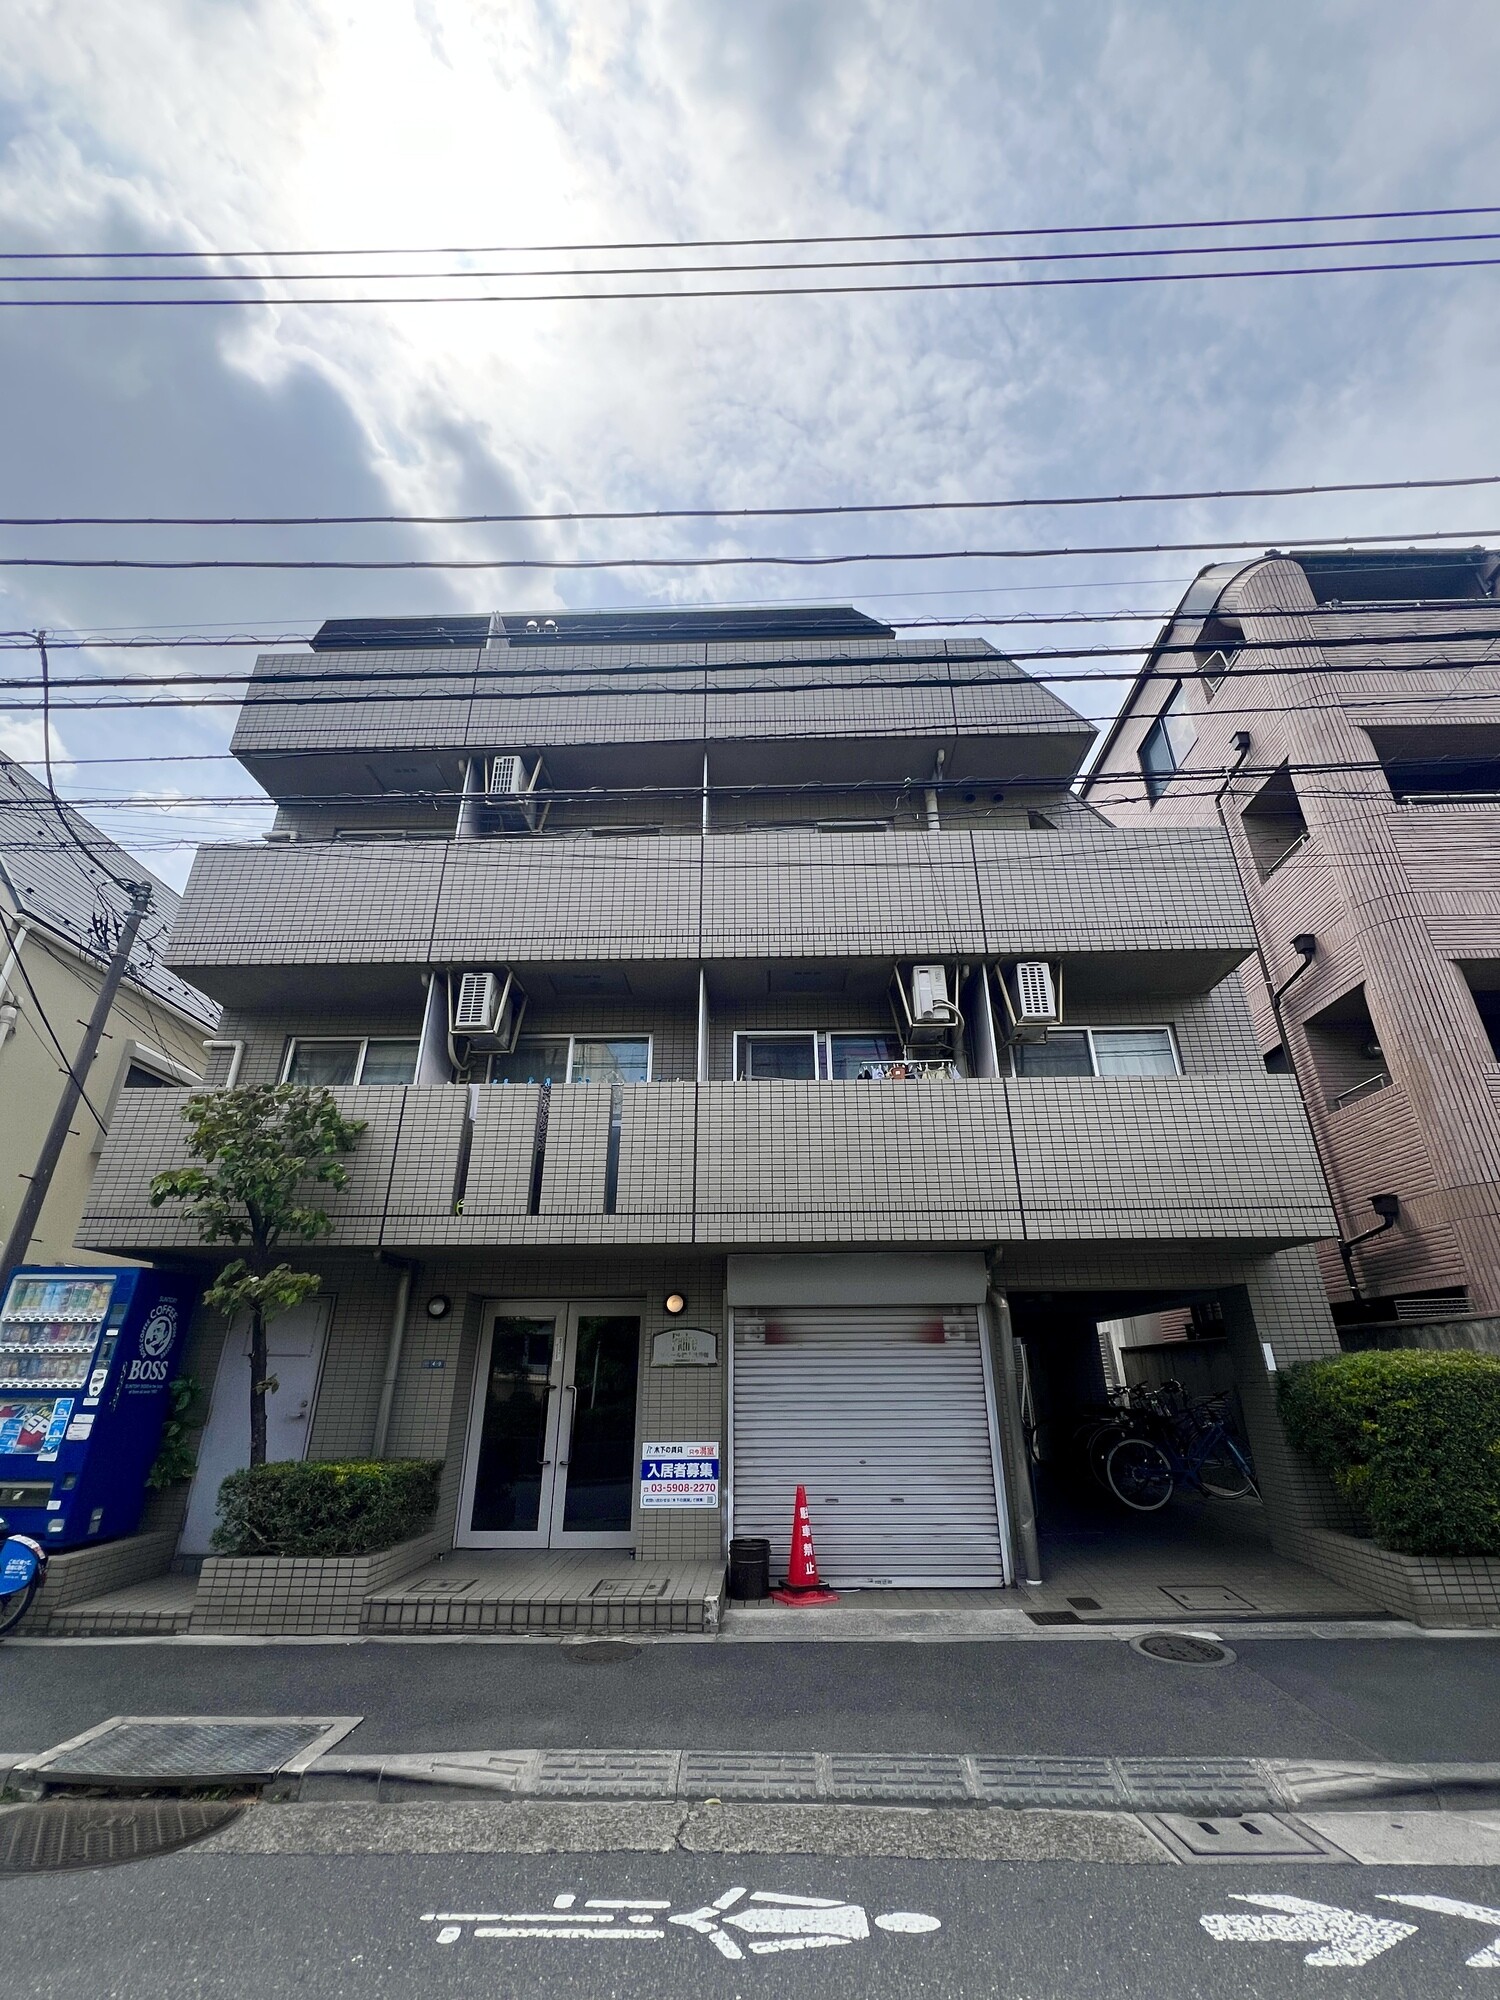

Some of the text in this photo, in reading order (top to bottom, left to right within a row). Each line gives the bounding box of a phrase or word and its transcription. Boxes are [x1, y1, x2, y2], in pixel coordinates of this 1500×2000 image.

[150, 1305, 179, 1321] COFFEE
[128, 1360, 169, 1381] BOSS
[647, 1462, 713, 1479] 入居者募集
[651, 1483, 716, 1493] 03-5908-2270
[800, 1506, 816, 1575] 駐車禁止
